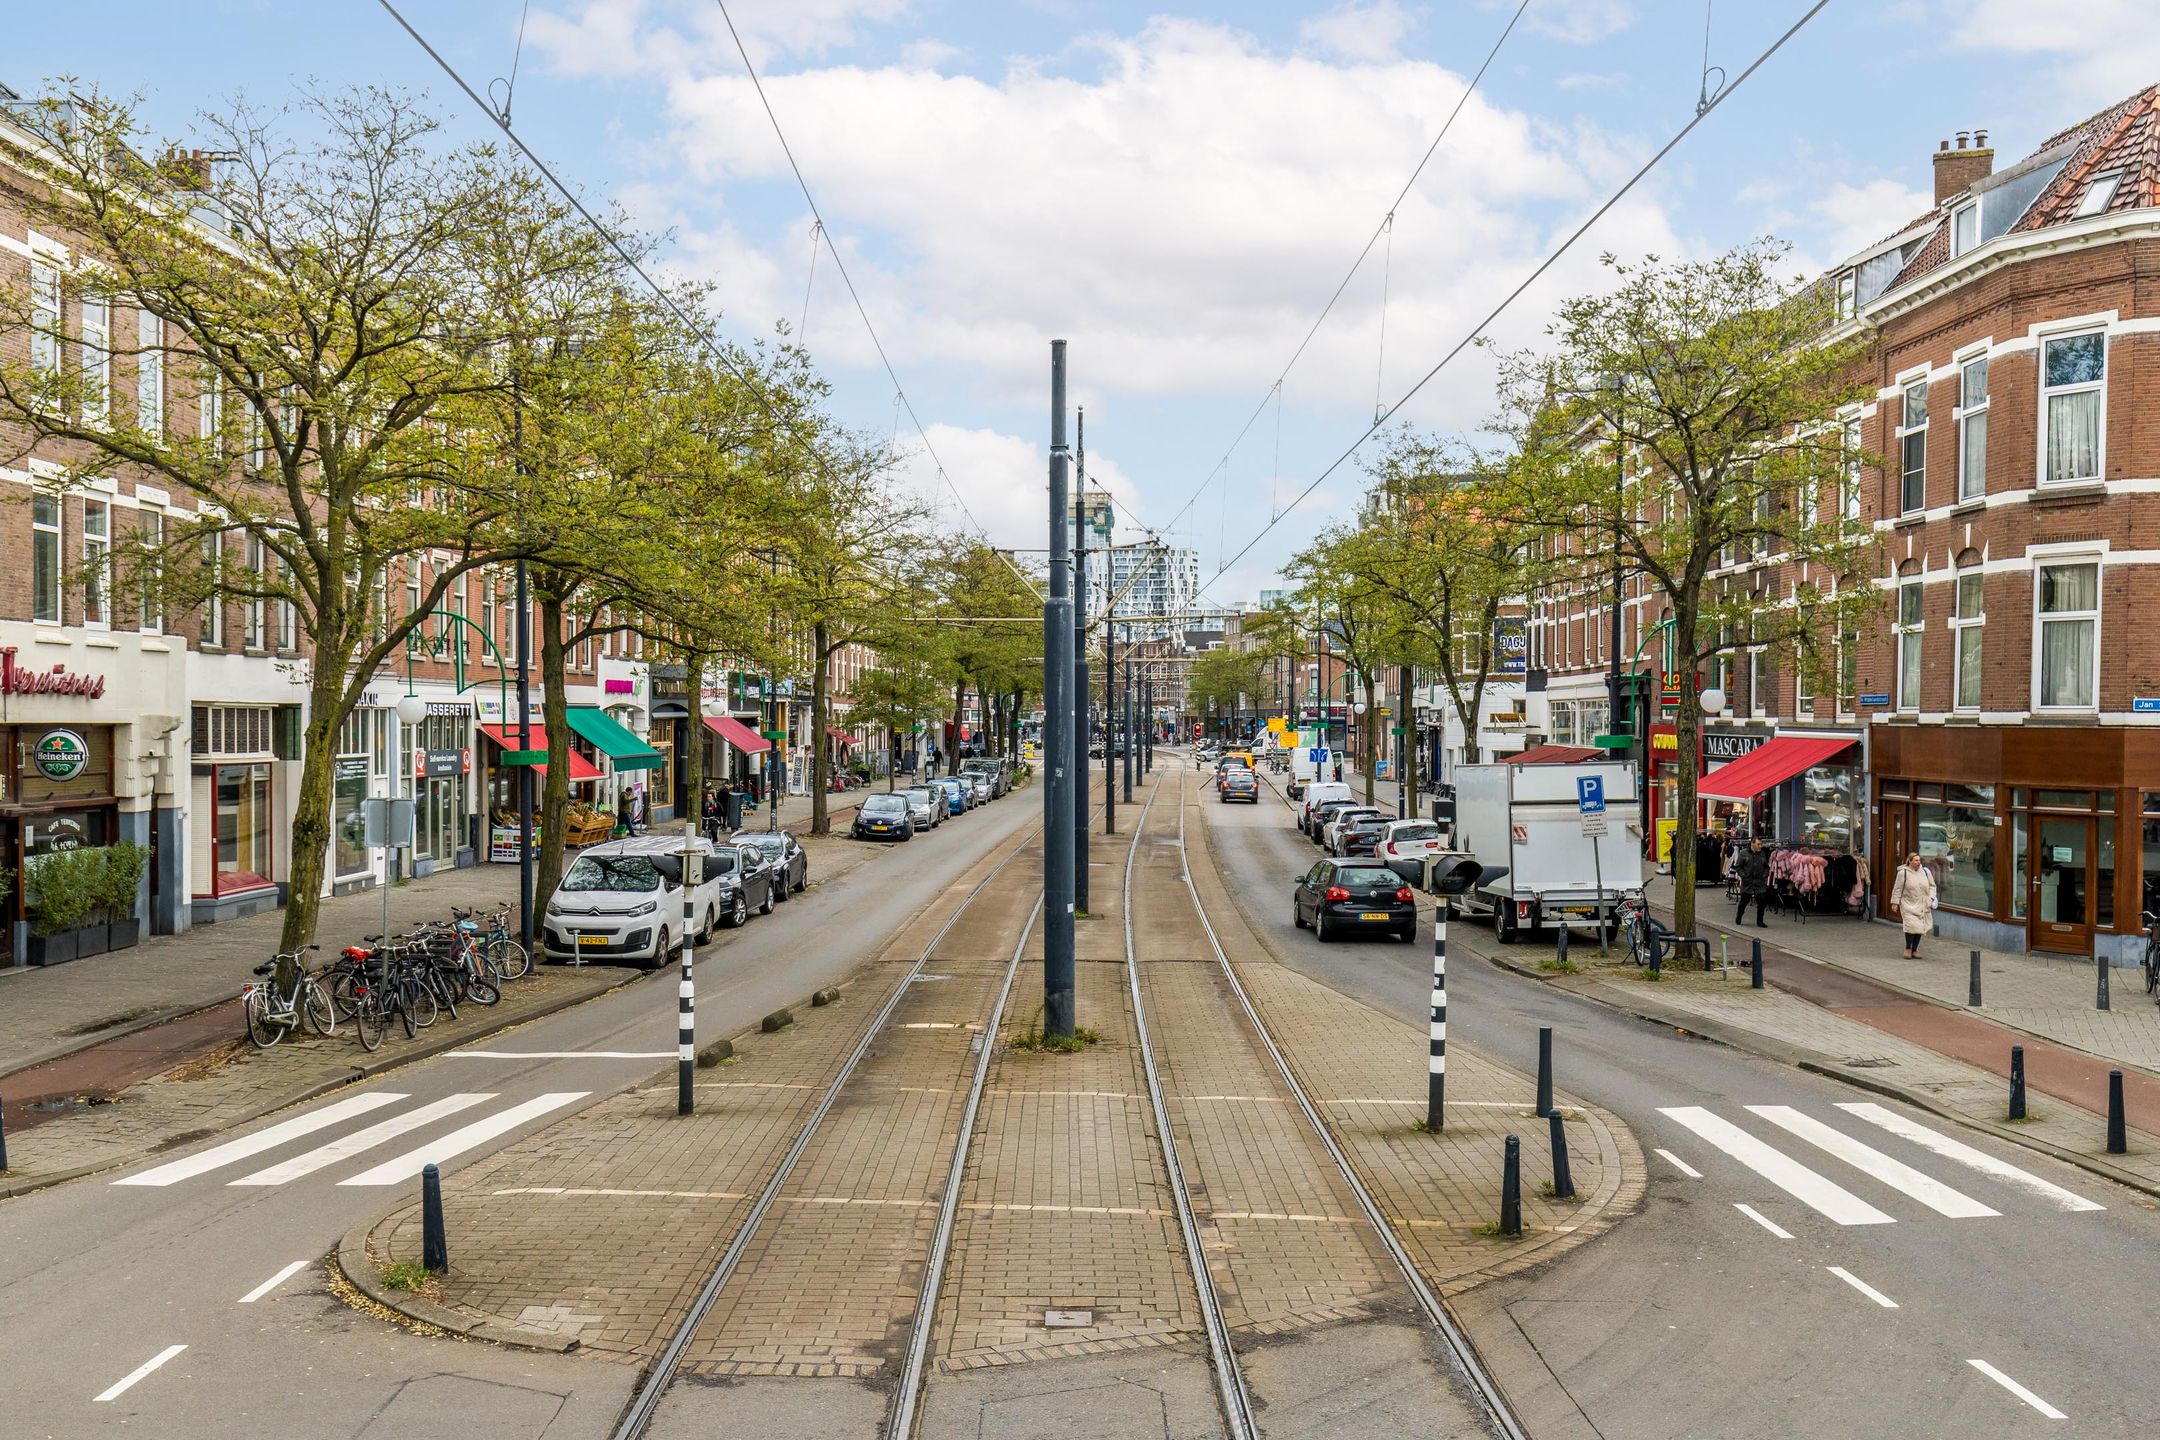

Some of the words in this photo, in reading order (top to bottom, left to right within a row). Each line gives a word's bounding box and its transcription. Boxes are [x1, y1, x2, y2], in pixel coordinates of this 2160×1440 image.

[427, 704, 474, 716] ASSERETT
[1707, 736, 1758, 756] MASCARA
[37, 752, 82, 761] Heineken
[1583, 779, 1598, 798] P
